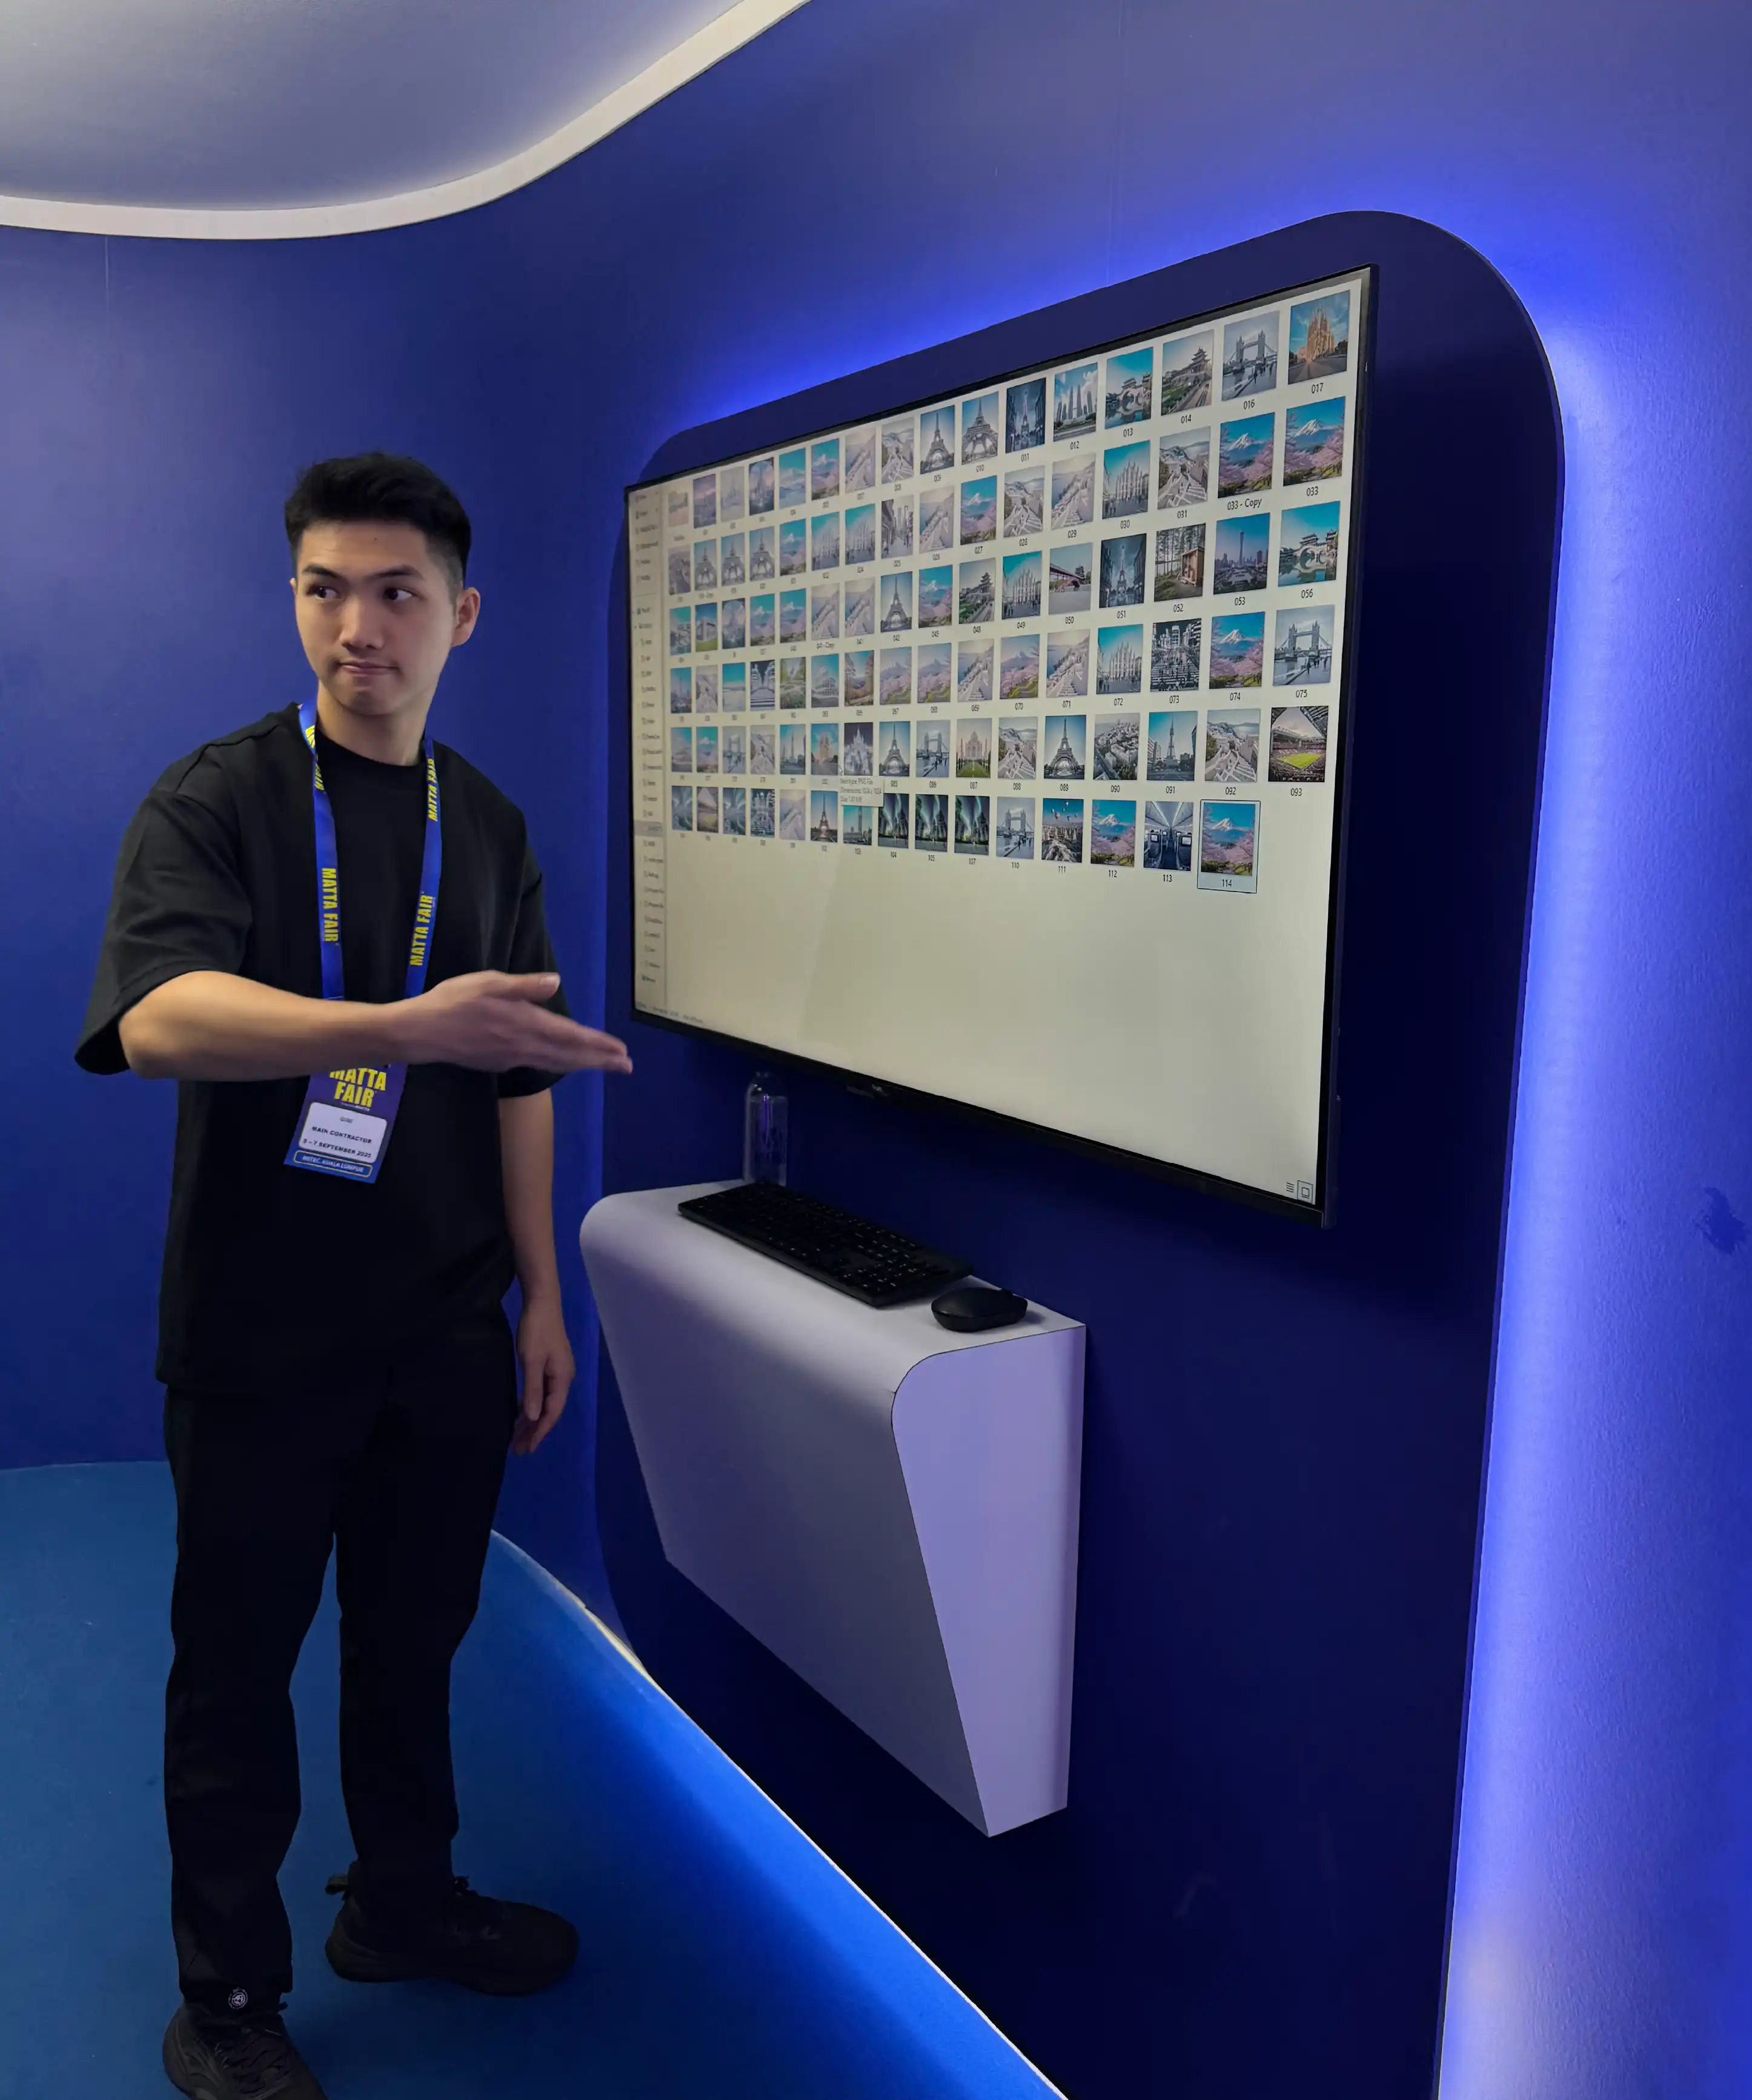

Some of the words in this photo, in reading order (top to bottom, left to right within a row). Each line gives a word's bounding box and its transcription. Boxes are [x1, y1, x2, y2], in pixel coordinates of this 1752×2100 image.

[1311, 382, 1324, 394] 017
[1243, 399, 1255, 410] 016
[1181, 414, 1192, 424] 014
[1123, 428, 1133, 438] 013
[1070, 440, 1080, 450] 012
[1021, 452, 1029, 462] 011
[975, 463, 984, 473] 010
[1306, 486, 1319, 497] 033
[1227, 501, 1239, 511] 033
[1244, 498, 1263, 509] Copy
[1176, 509, 1187, 519] 031
[1120, 519, 1130, 529] 030
[1067, 529, 1077, 538] 029
[1019, 538, 1028, 547] 028
[974, 546, 983, 554] 027
[1301, 588, 1313, 599] 056
[1234, 596, 1246, 606] 053
[1173, 603, 1184, 612] 052
[1065, 615, 1075, 624] 050
[1117, 610, 1126, 619] 051
[1229, 692, 1241, 701] 074
[1295, 689, 1308, 698] 075
[1062, 700, 1071, 709] 071
[1113, 697, 1123, 706] 072
[1169, 695, 1180, 704] 073
[1015, 702, 1024, 710] 070
[1060, 783, 1069, 792] 089
[1110, 784, 1121, 793] 090
[1166, 786, 1175, 794] 091
[1225, 786, 1236, 795] 092
[1290, 787, 1302, 797] 093
[427, 784, 438, 822] MATTA
[1108, 869, 1117, 878] 112
[1163, 874, 1172, 883] 113
[322, 867, 337, 909] MATTA
[1222, 879, 1232, 887] 114
[416, 895, 433, 923] FAIR
[323, 913, 339, 942] FAIR
[410, 926, 429, 966] MATTA
[334, 1081, 375, 1108] FAIR
[330, 1130, 373, 1144] CONTRACTOR
[319, 1142, 356, 1154] SEPTEMBER
